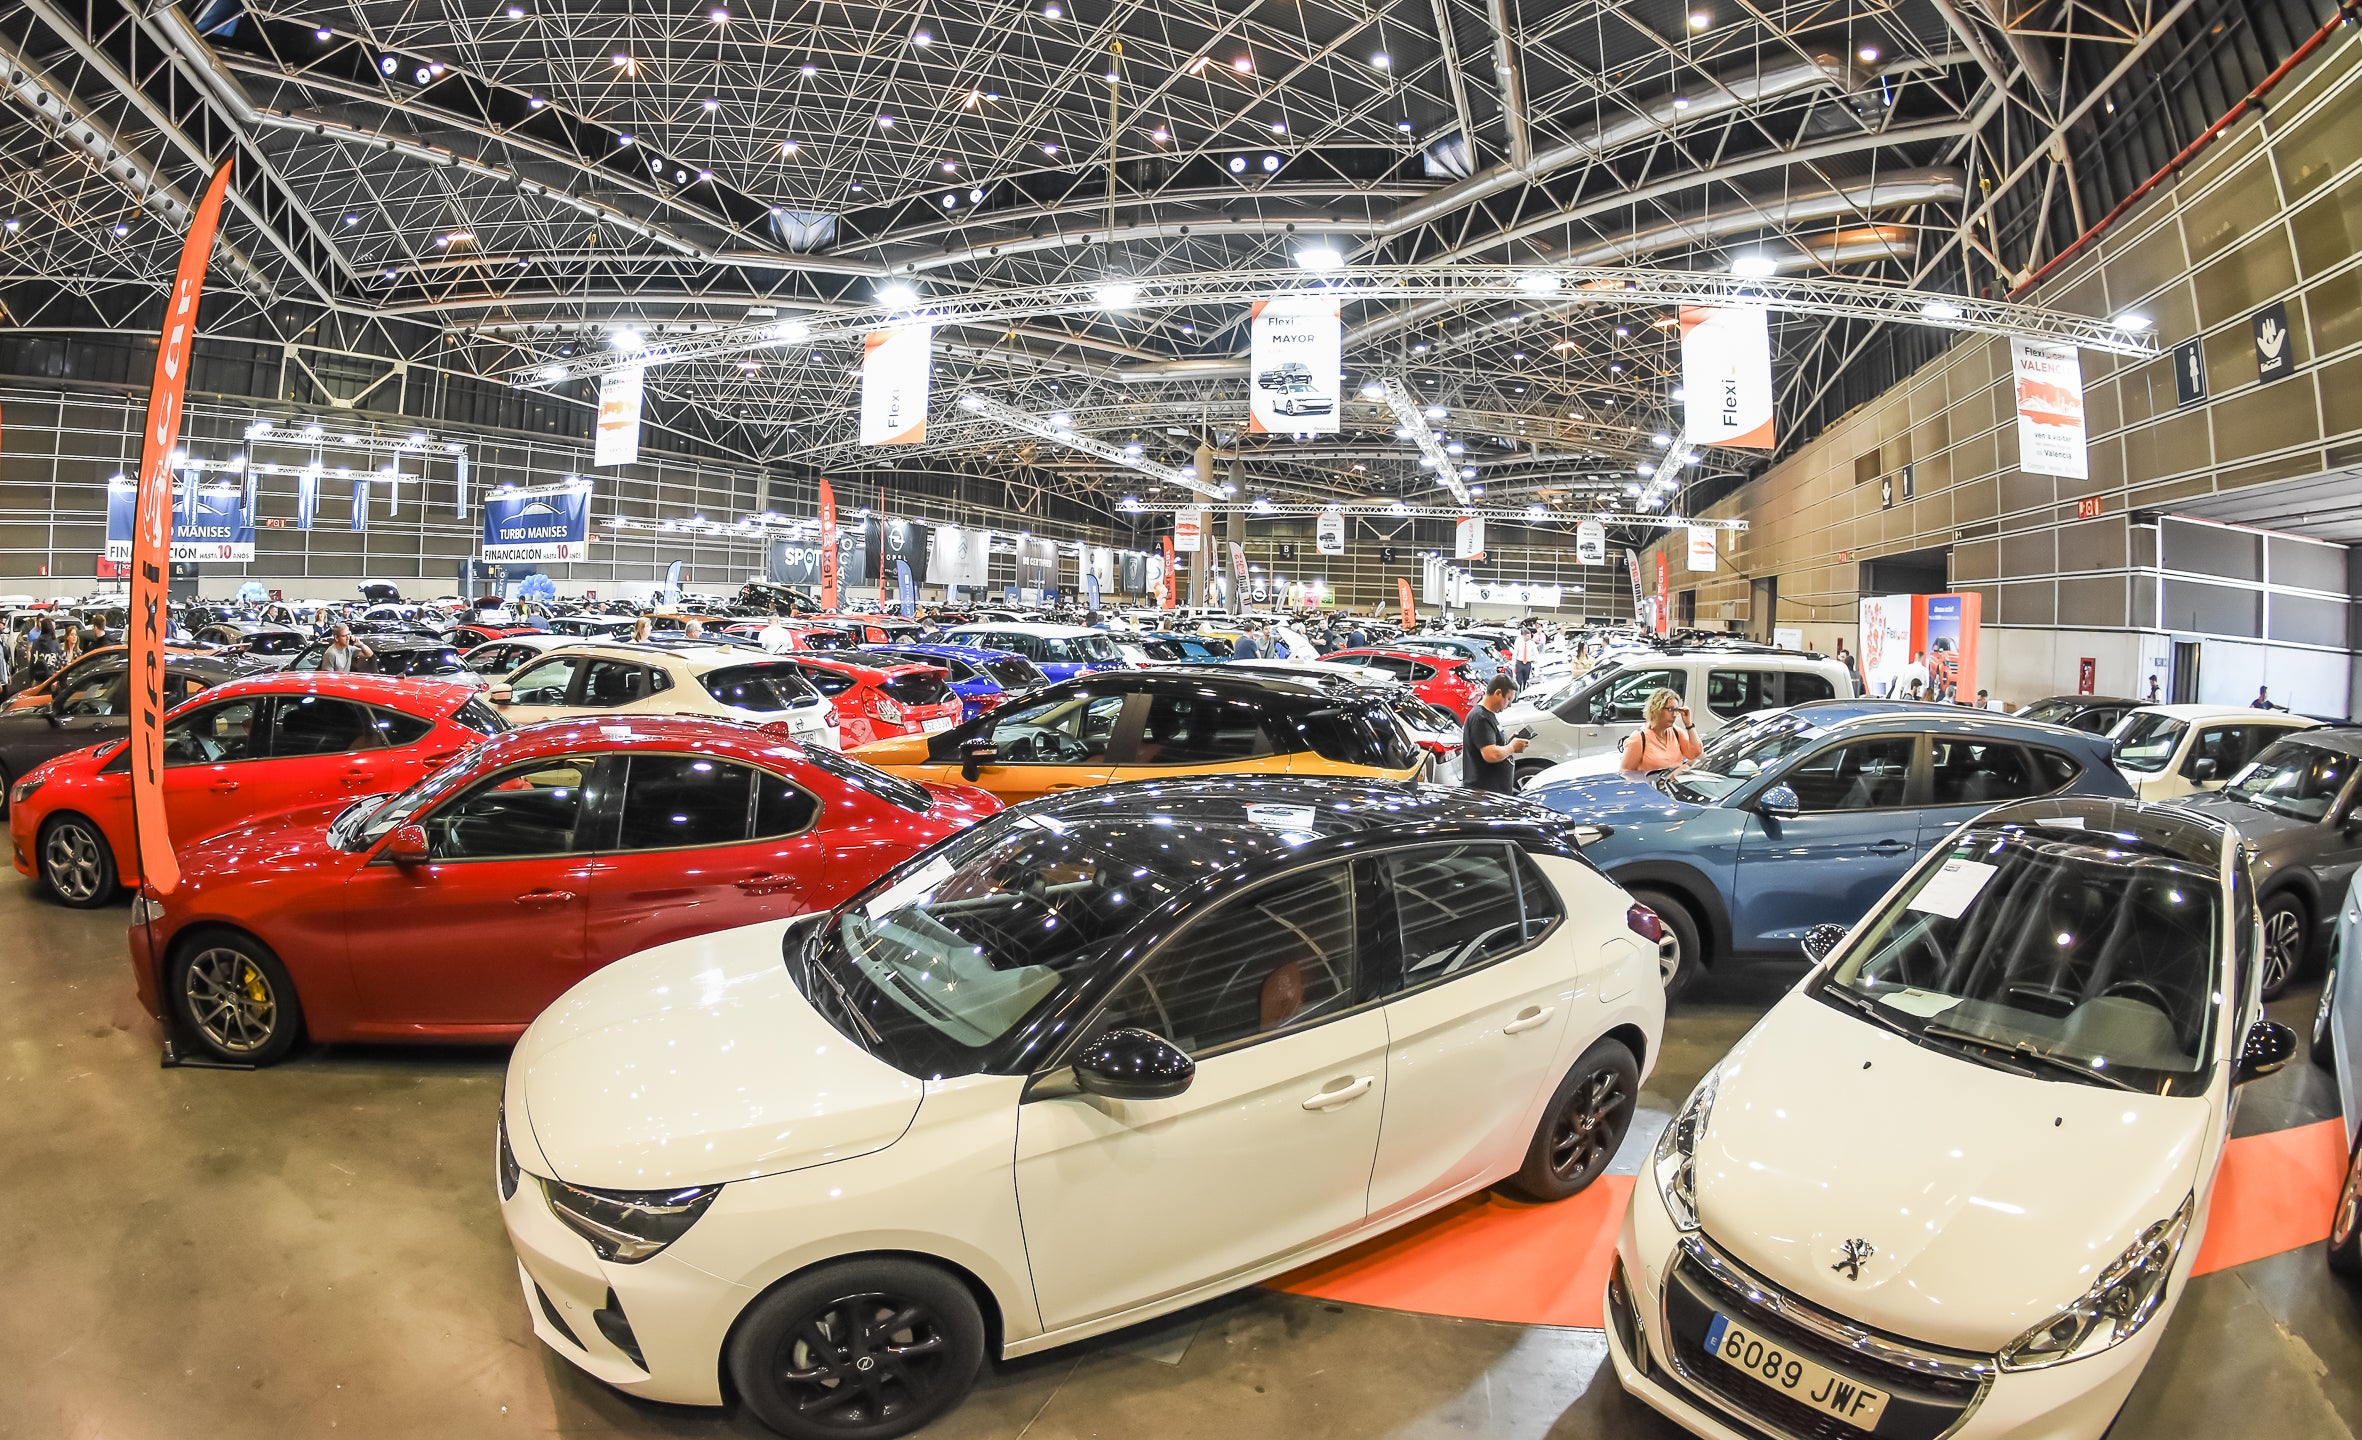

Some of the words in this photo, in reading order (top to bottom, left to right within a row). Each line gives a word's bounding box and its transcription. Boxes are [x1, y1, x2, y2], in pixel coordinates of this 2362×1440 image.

[1268, 317, 1294, 326] Flexi
[1272, 334, 1315, 343] MAYOR
[888, 389, 900, 428] Flexi
[1722, 379, 1738, 427] Flexi
[2044, 449, 2072, 459] Valencia
[177, 526, 232, 538] MANISES
[499, 529, 526, 540] TURBO
[527, 525, 568, 538] MANISES
[217, 544, 232, 560] 10
[484, 546, 542, 560] FINANCIACIÓN
[557, 544, 568, 559] 10
[1155, 542, 1161, 550] A
[1725, 1330, 1803, 1389] 6089
[1810, 1377, 1877, 1418] JWF
